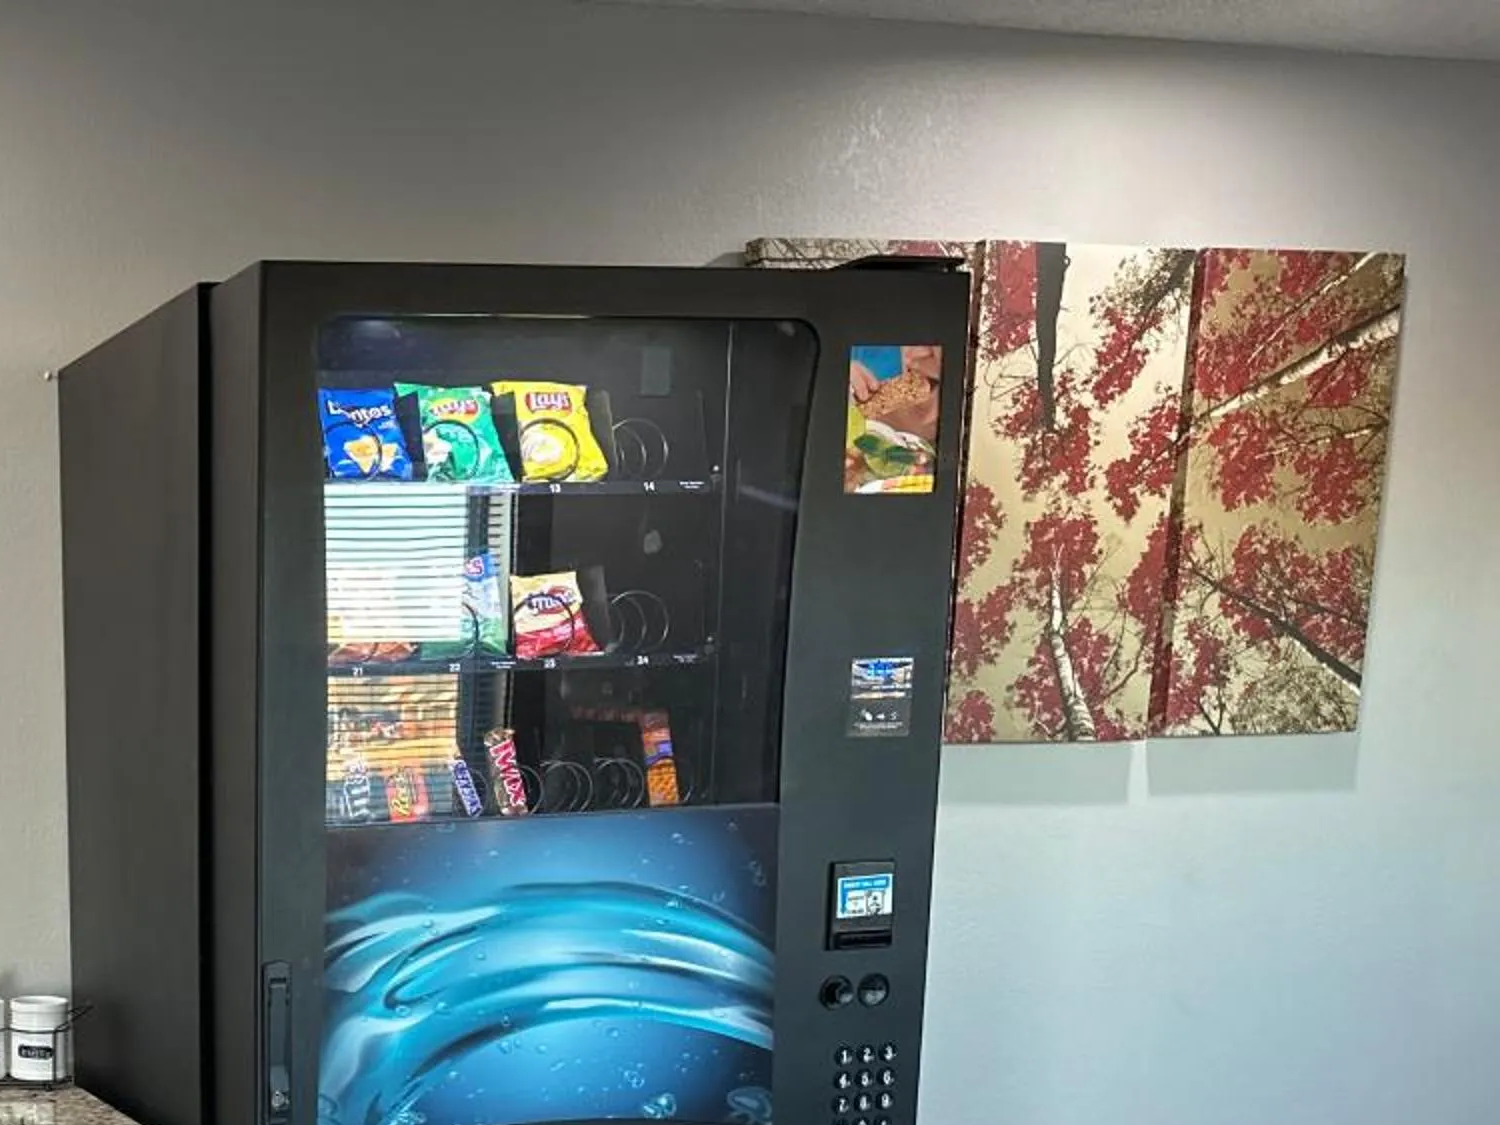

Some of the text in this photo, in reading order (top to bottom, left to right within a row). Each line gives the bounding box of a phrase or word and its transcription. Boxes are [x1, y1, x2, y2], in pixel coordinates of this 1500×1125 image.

[327, 399, 392, 426] Dritos
[550, 484, 562, 493] 13
[643, 481, 656, 491] 14
